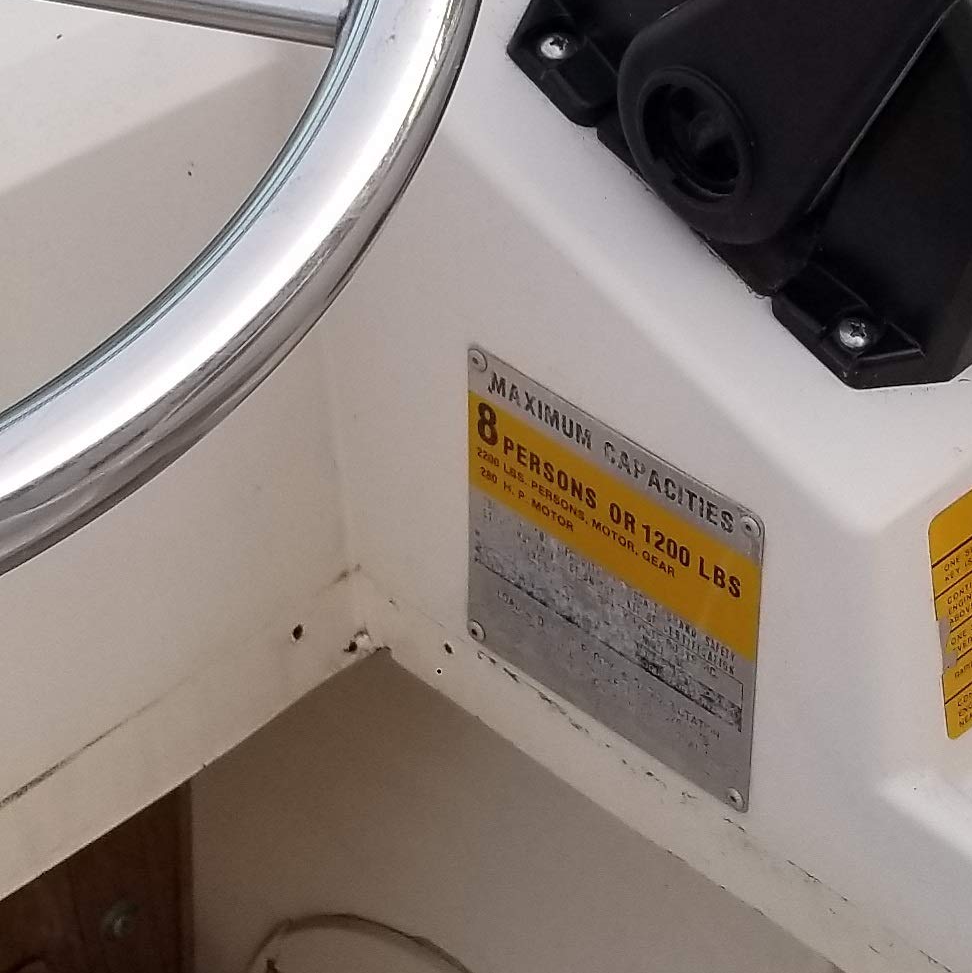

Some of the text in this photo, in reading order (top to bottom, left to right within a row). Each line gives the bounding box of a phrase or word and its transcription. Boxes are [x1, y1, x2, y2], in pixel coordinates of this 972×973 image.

[487, 371, 736, 534] MAXIMUM CAPACITIES
[476, 401, 499, 447] 8
[502, 437, 598, 509] PERSONS
[608, 502, 636, 533] OR
[641, 524, 691, 567] 1200
[698, 558, 742, 598] LBS
[530, 498, 574, 532] MOTOR
[530, 480, 588, 525] PERSONS,
[591, 518, 638, 556] MOTOR,
[943, 555, 960, 573] ONE
